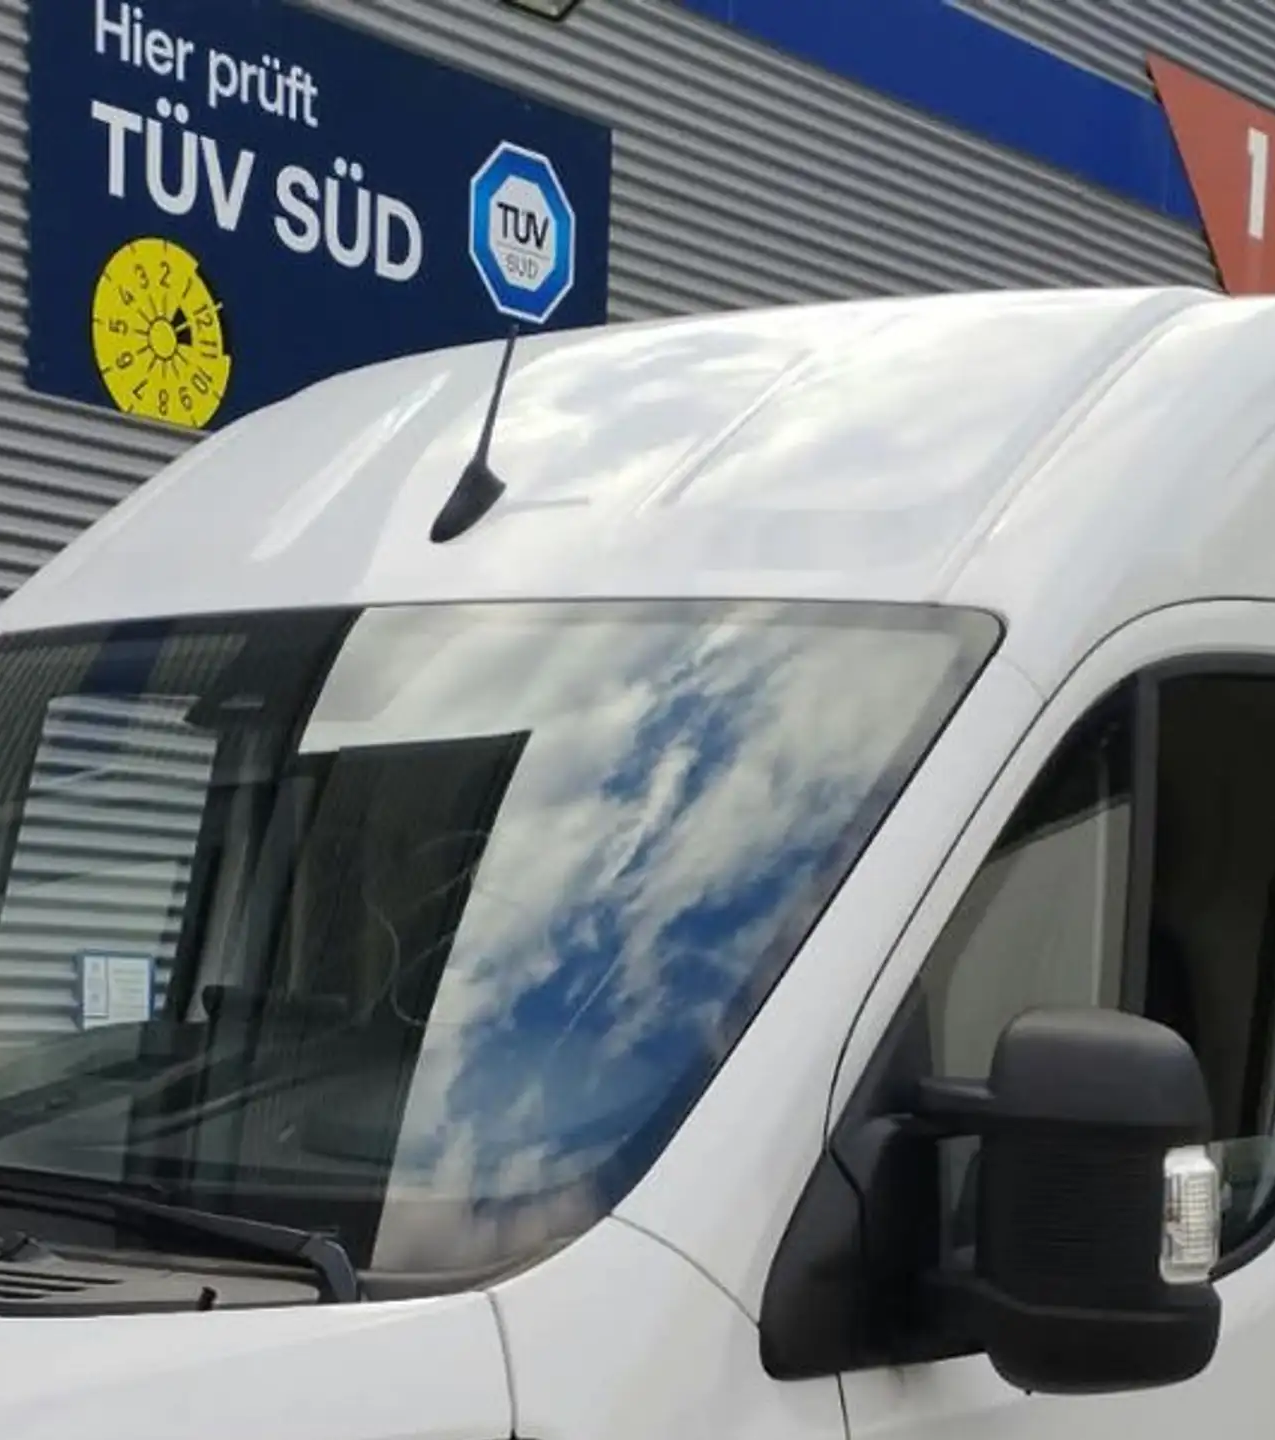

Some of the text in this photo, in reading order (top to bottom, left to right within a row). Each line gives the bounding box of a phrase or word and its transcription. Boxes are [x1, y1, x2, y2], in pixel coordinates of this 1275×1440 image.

[95, 0, 318, 128] Hier prüft
[92, 97, 423, 282] TÜV SÜD
[1247, 127, 1269, 240] 1
[497, 201, 549, 250] TÜV
[134, 264, 149, 289] 3
[158, 261, 171, 288] 2
[118, 285, 135, 305] 4
[182, 278, 193, 299] 1
[108, 319, 128, 335] 5
[192, 304, 214, 328] 12
[115, 352, 133, 369] 6
[199, 339, 218, 359] 11
[132, 379, 148, 400] 7
[190, 365, 213, 394] 10
[158, 389, 170, 416] 8
[177, 386, 193, 411] 9
